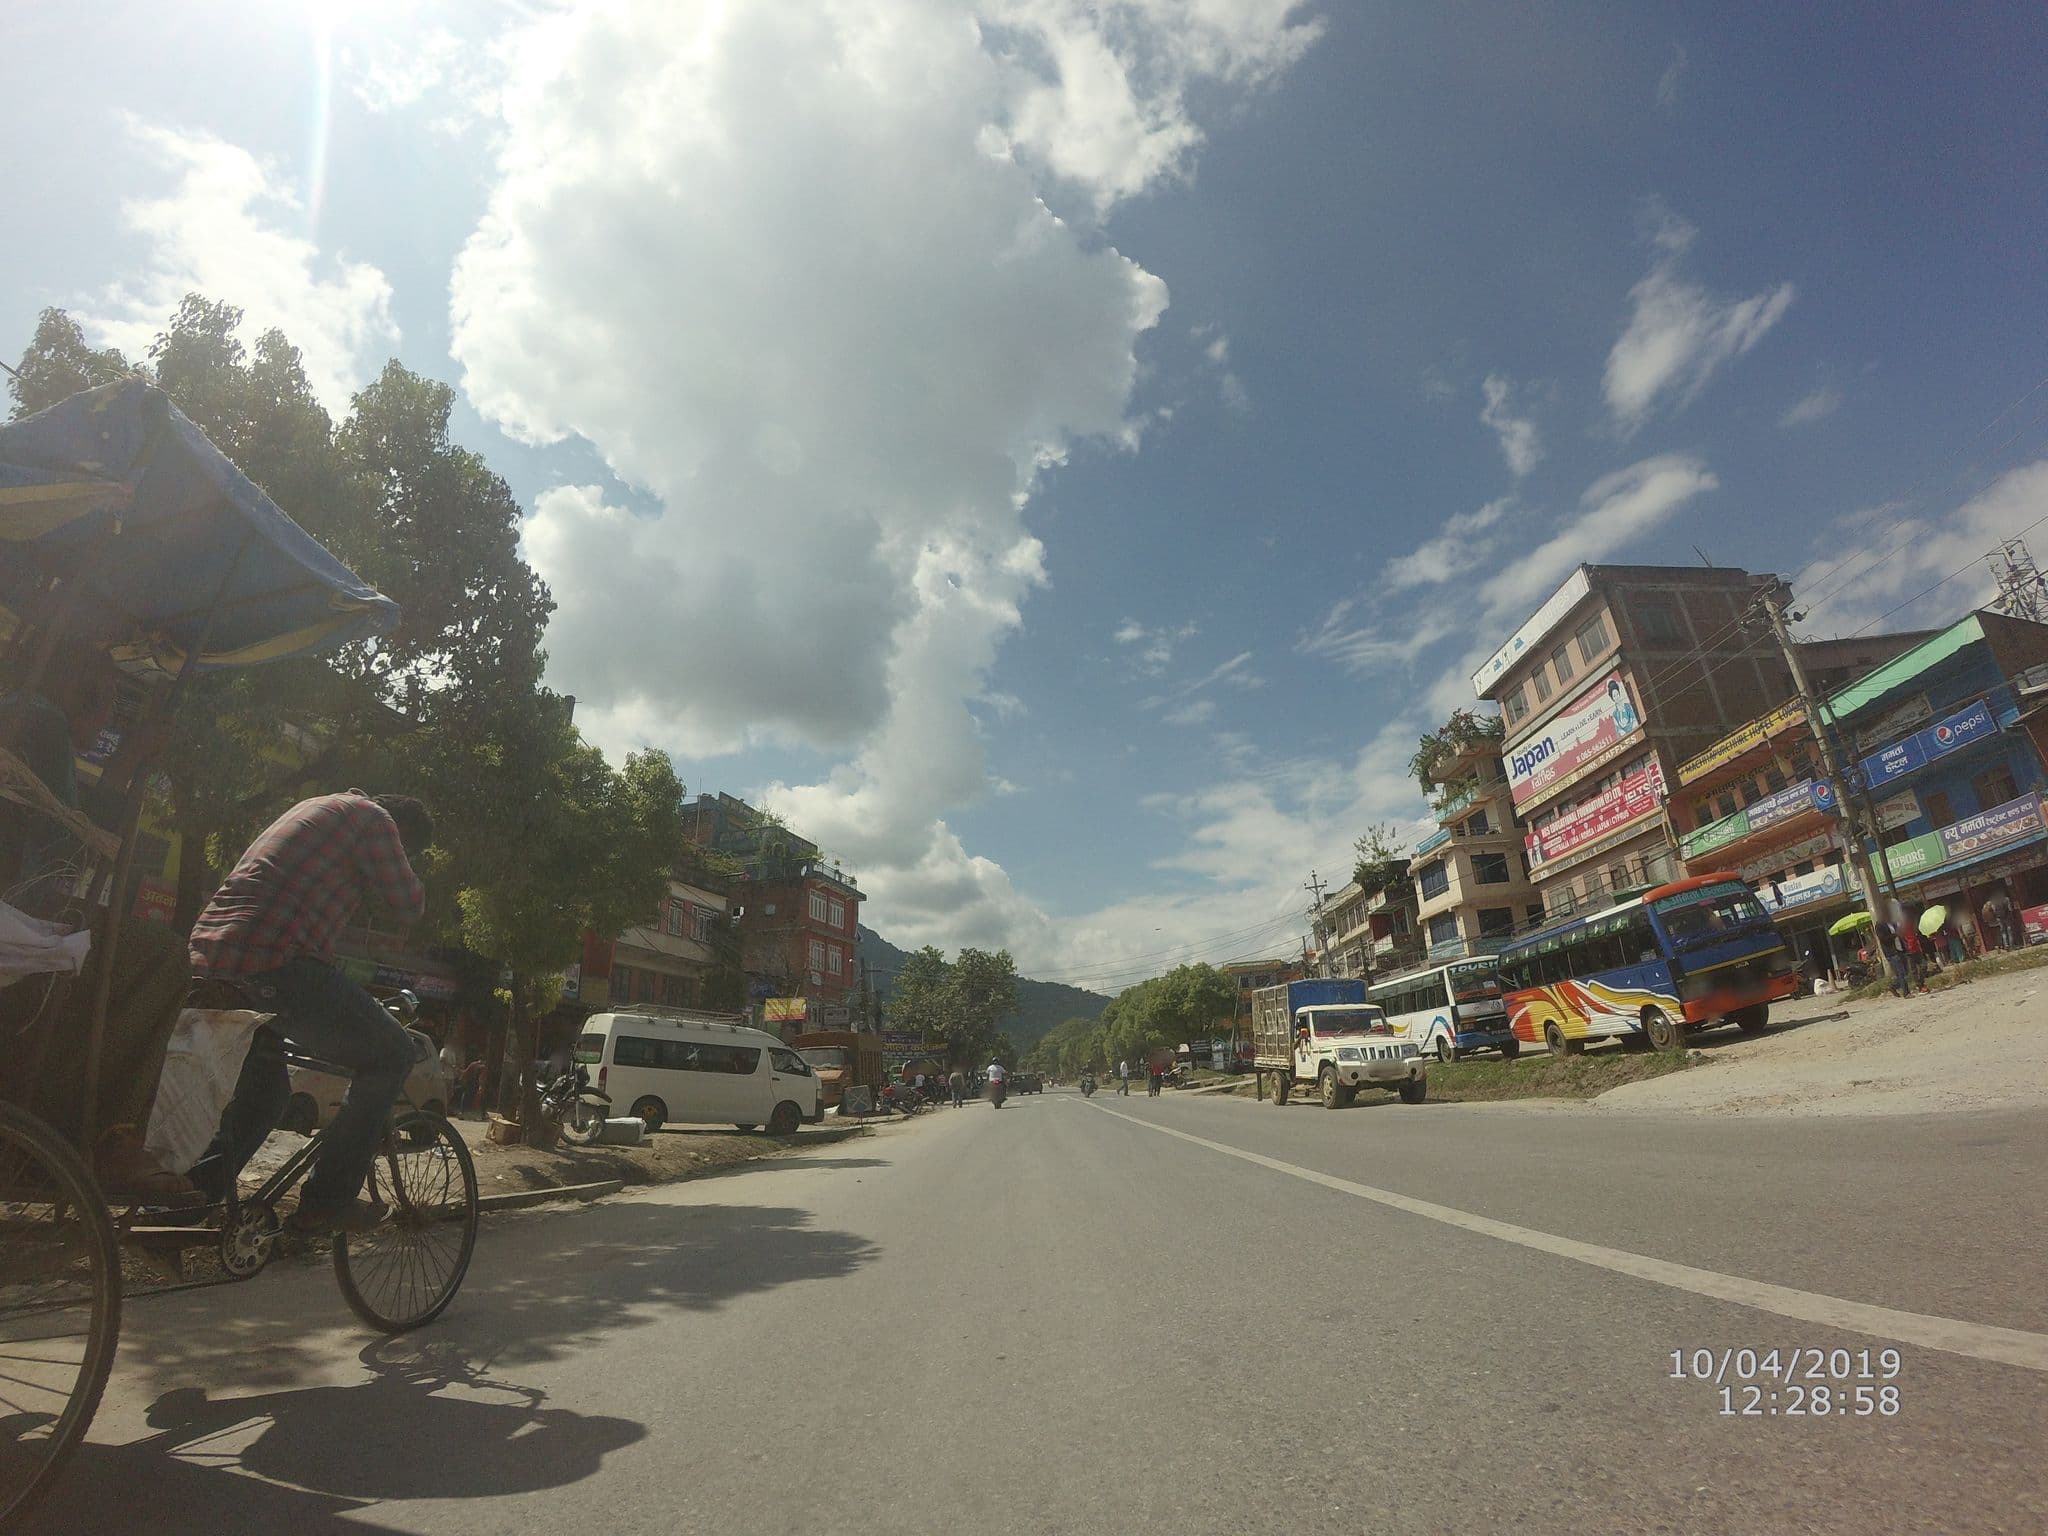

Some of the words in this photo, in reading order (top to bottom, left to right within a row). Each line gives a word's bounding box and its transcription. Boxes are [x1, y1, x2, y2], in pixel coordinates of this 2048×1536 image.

[1954, 711, 1986, 737] pepsi
[1511, 736, 1555, 780] Japan
[1600, 736, 1637, 764] RAFFLES
[1531, 767, 1556, 789] raffles
[1890, 848, 1926, 869] TUBORG
